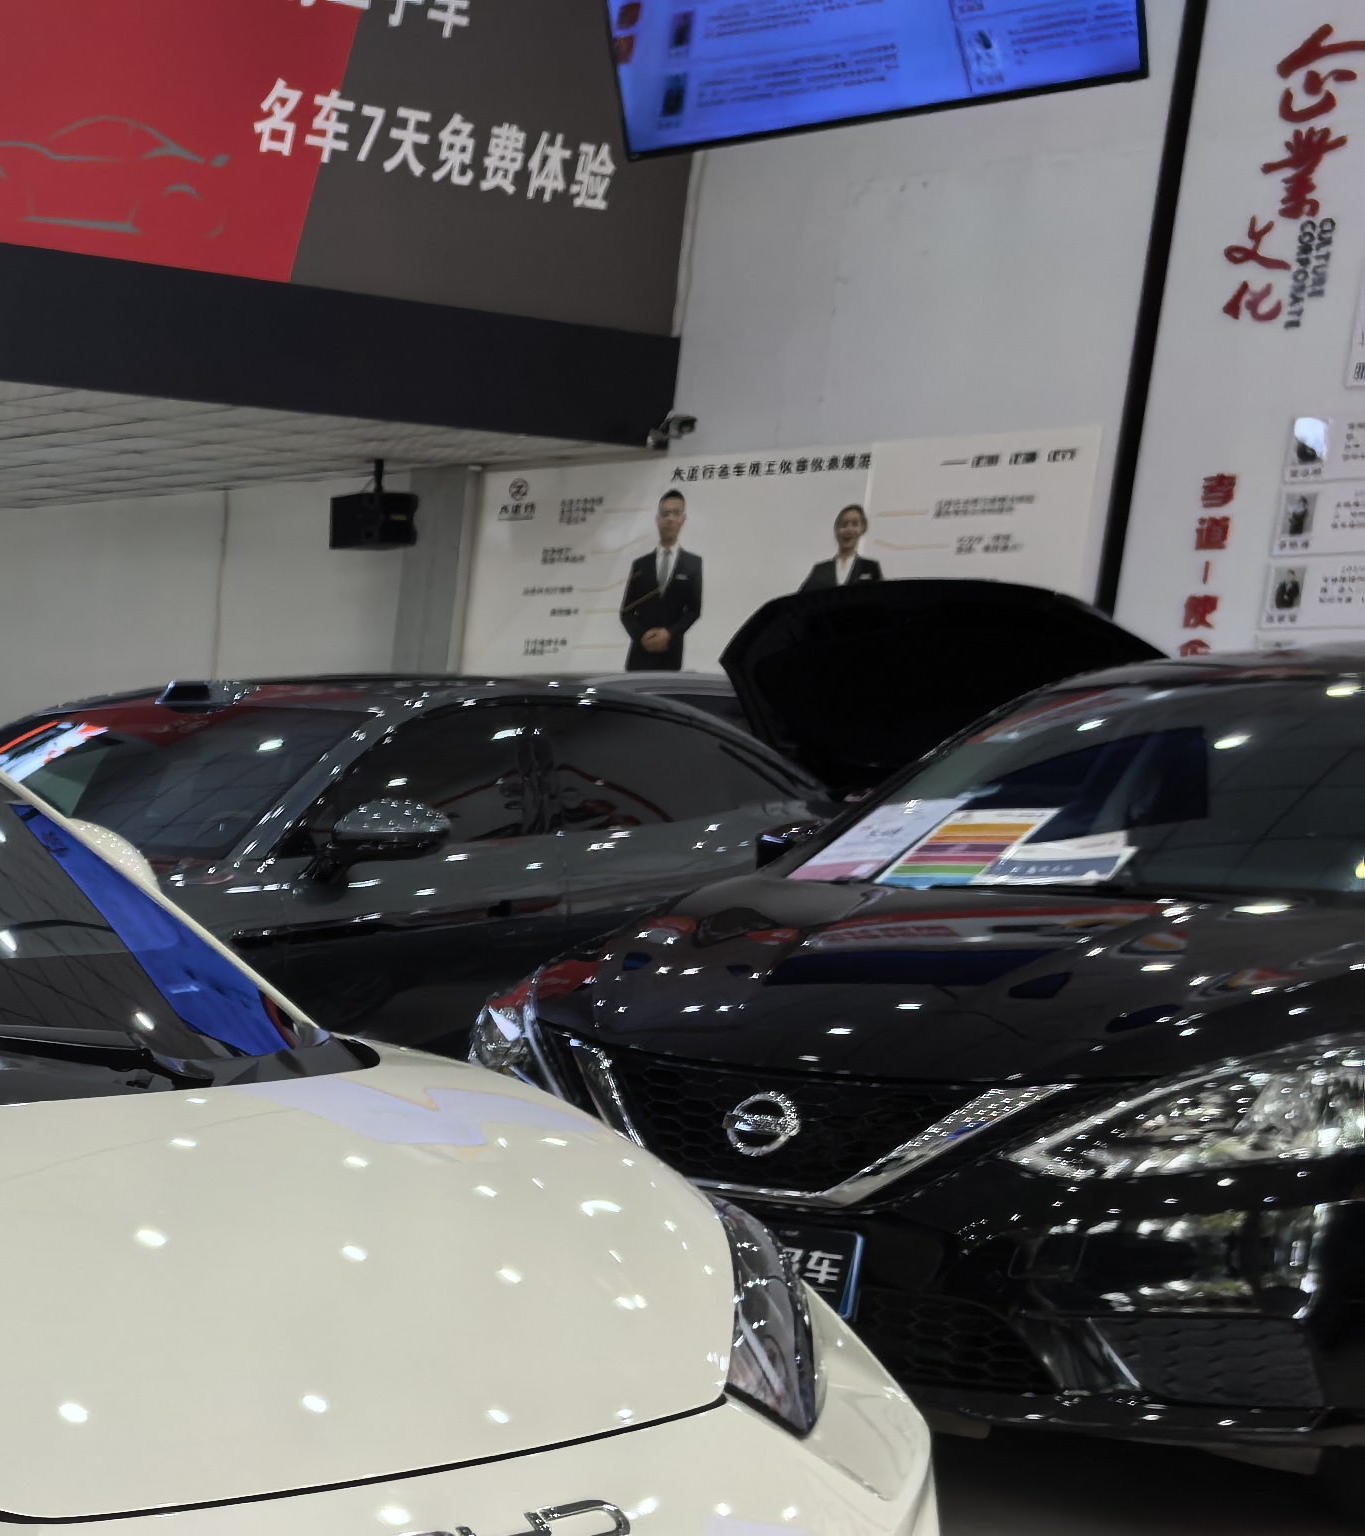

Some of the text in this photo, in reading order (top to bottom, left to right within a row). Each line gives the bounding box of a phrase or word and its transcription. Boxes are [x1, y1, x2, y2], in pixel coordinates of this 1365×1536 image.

[254, 78, 615, 210] 名车7天免费体验
